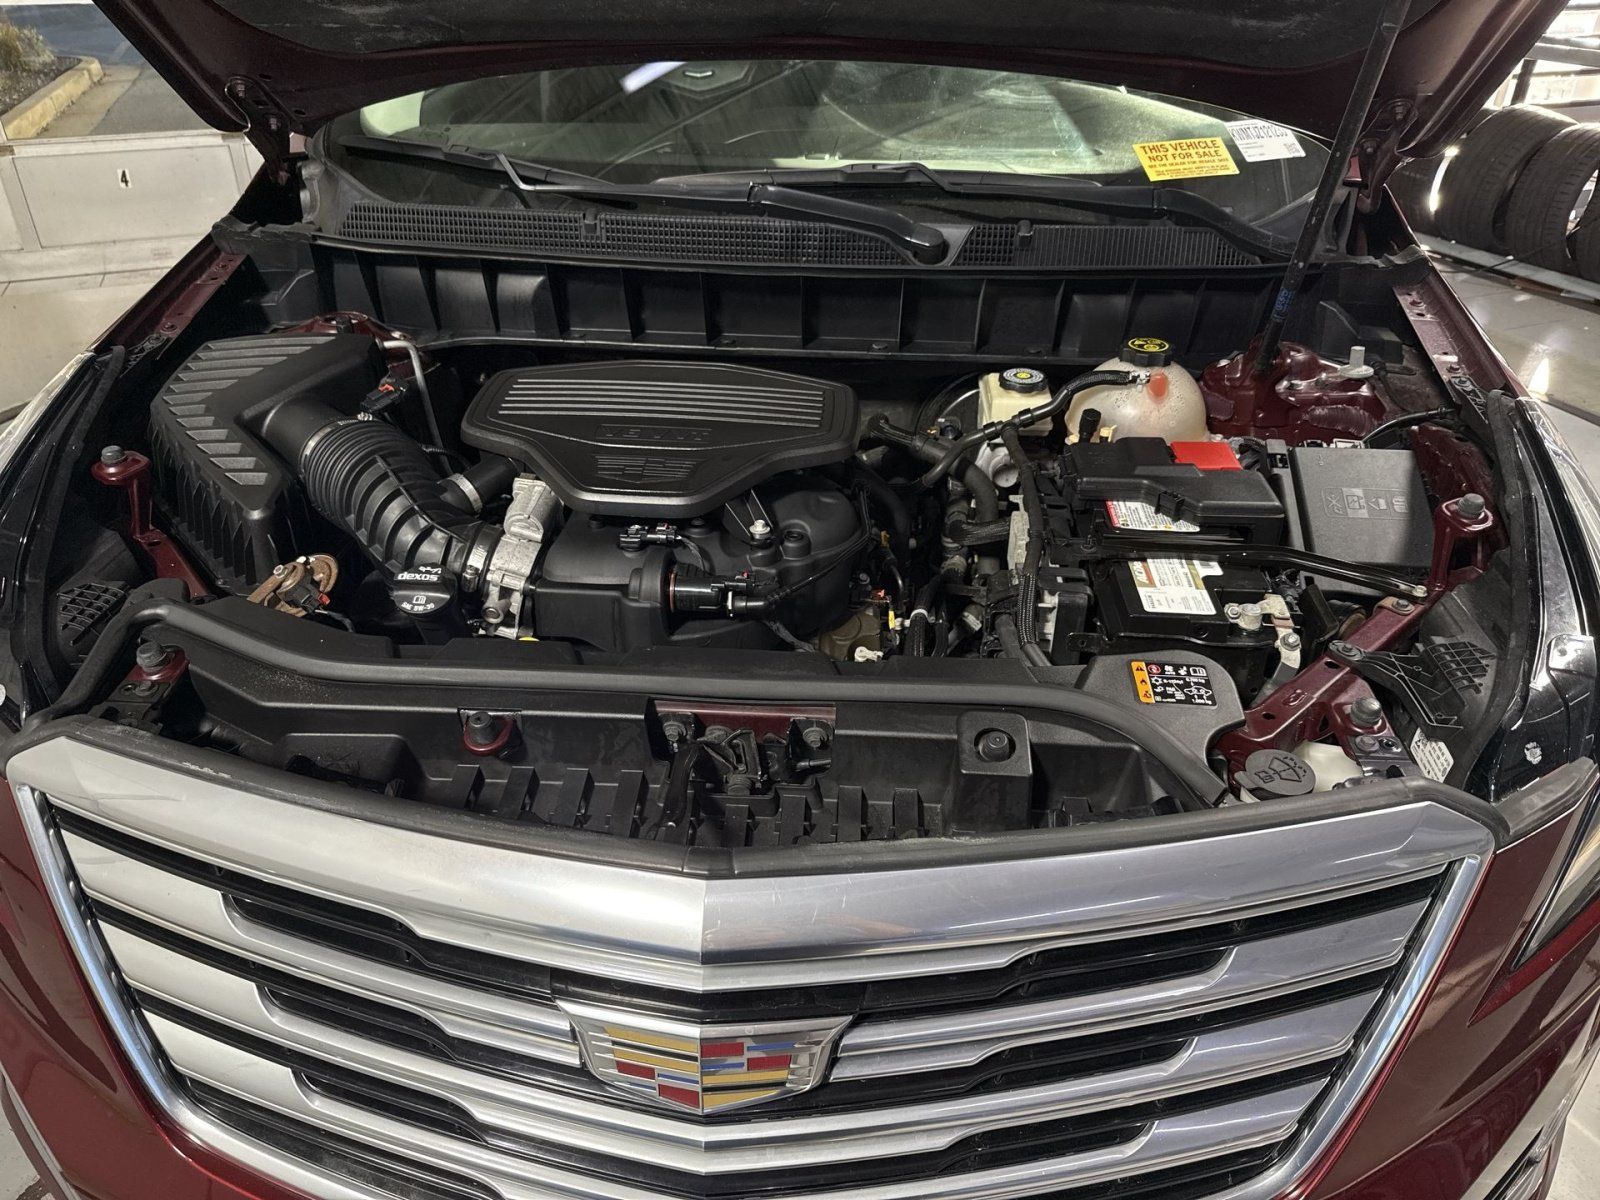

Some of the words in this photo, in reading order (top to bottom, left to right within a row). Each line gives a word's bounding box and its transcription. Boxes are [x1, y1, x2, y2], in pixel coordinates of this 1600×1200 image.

[1140, 143, 1169, 155] THIS
[1169, 140, 1221, 152] VEHICLE
[1148, 154, 1169, 163] NOT
[1171, 152, 1194, 160] FOR
[1195, 150, 1222, 158] SALE
[120, 169, 129, 187] 4
[397, 571, 440, 581] dexos
[401, 602, 413, 611] SAE
